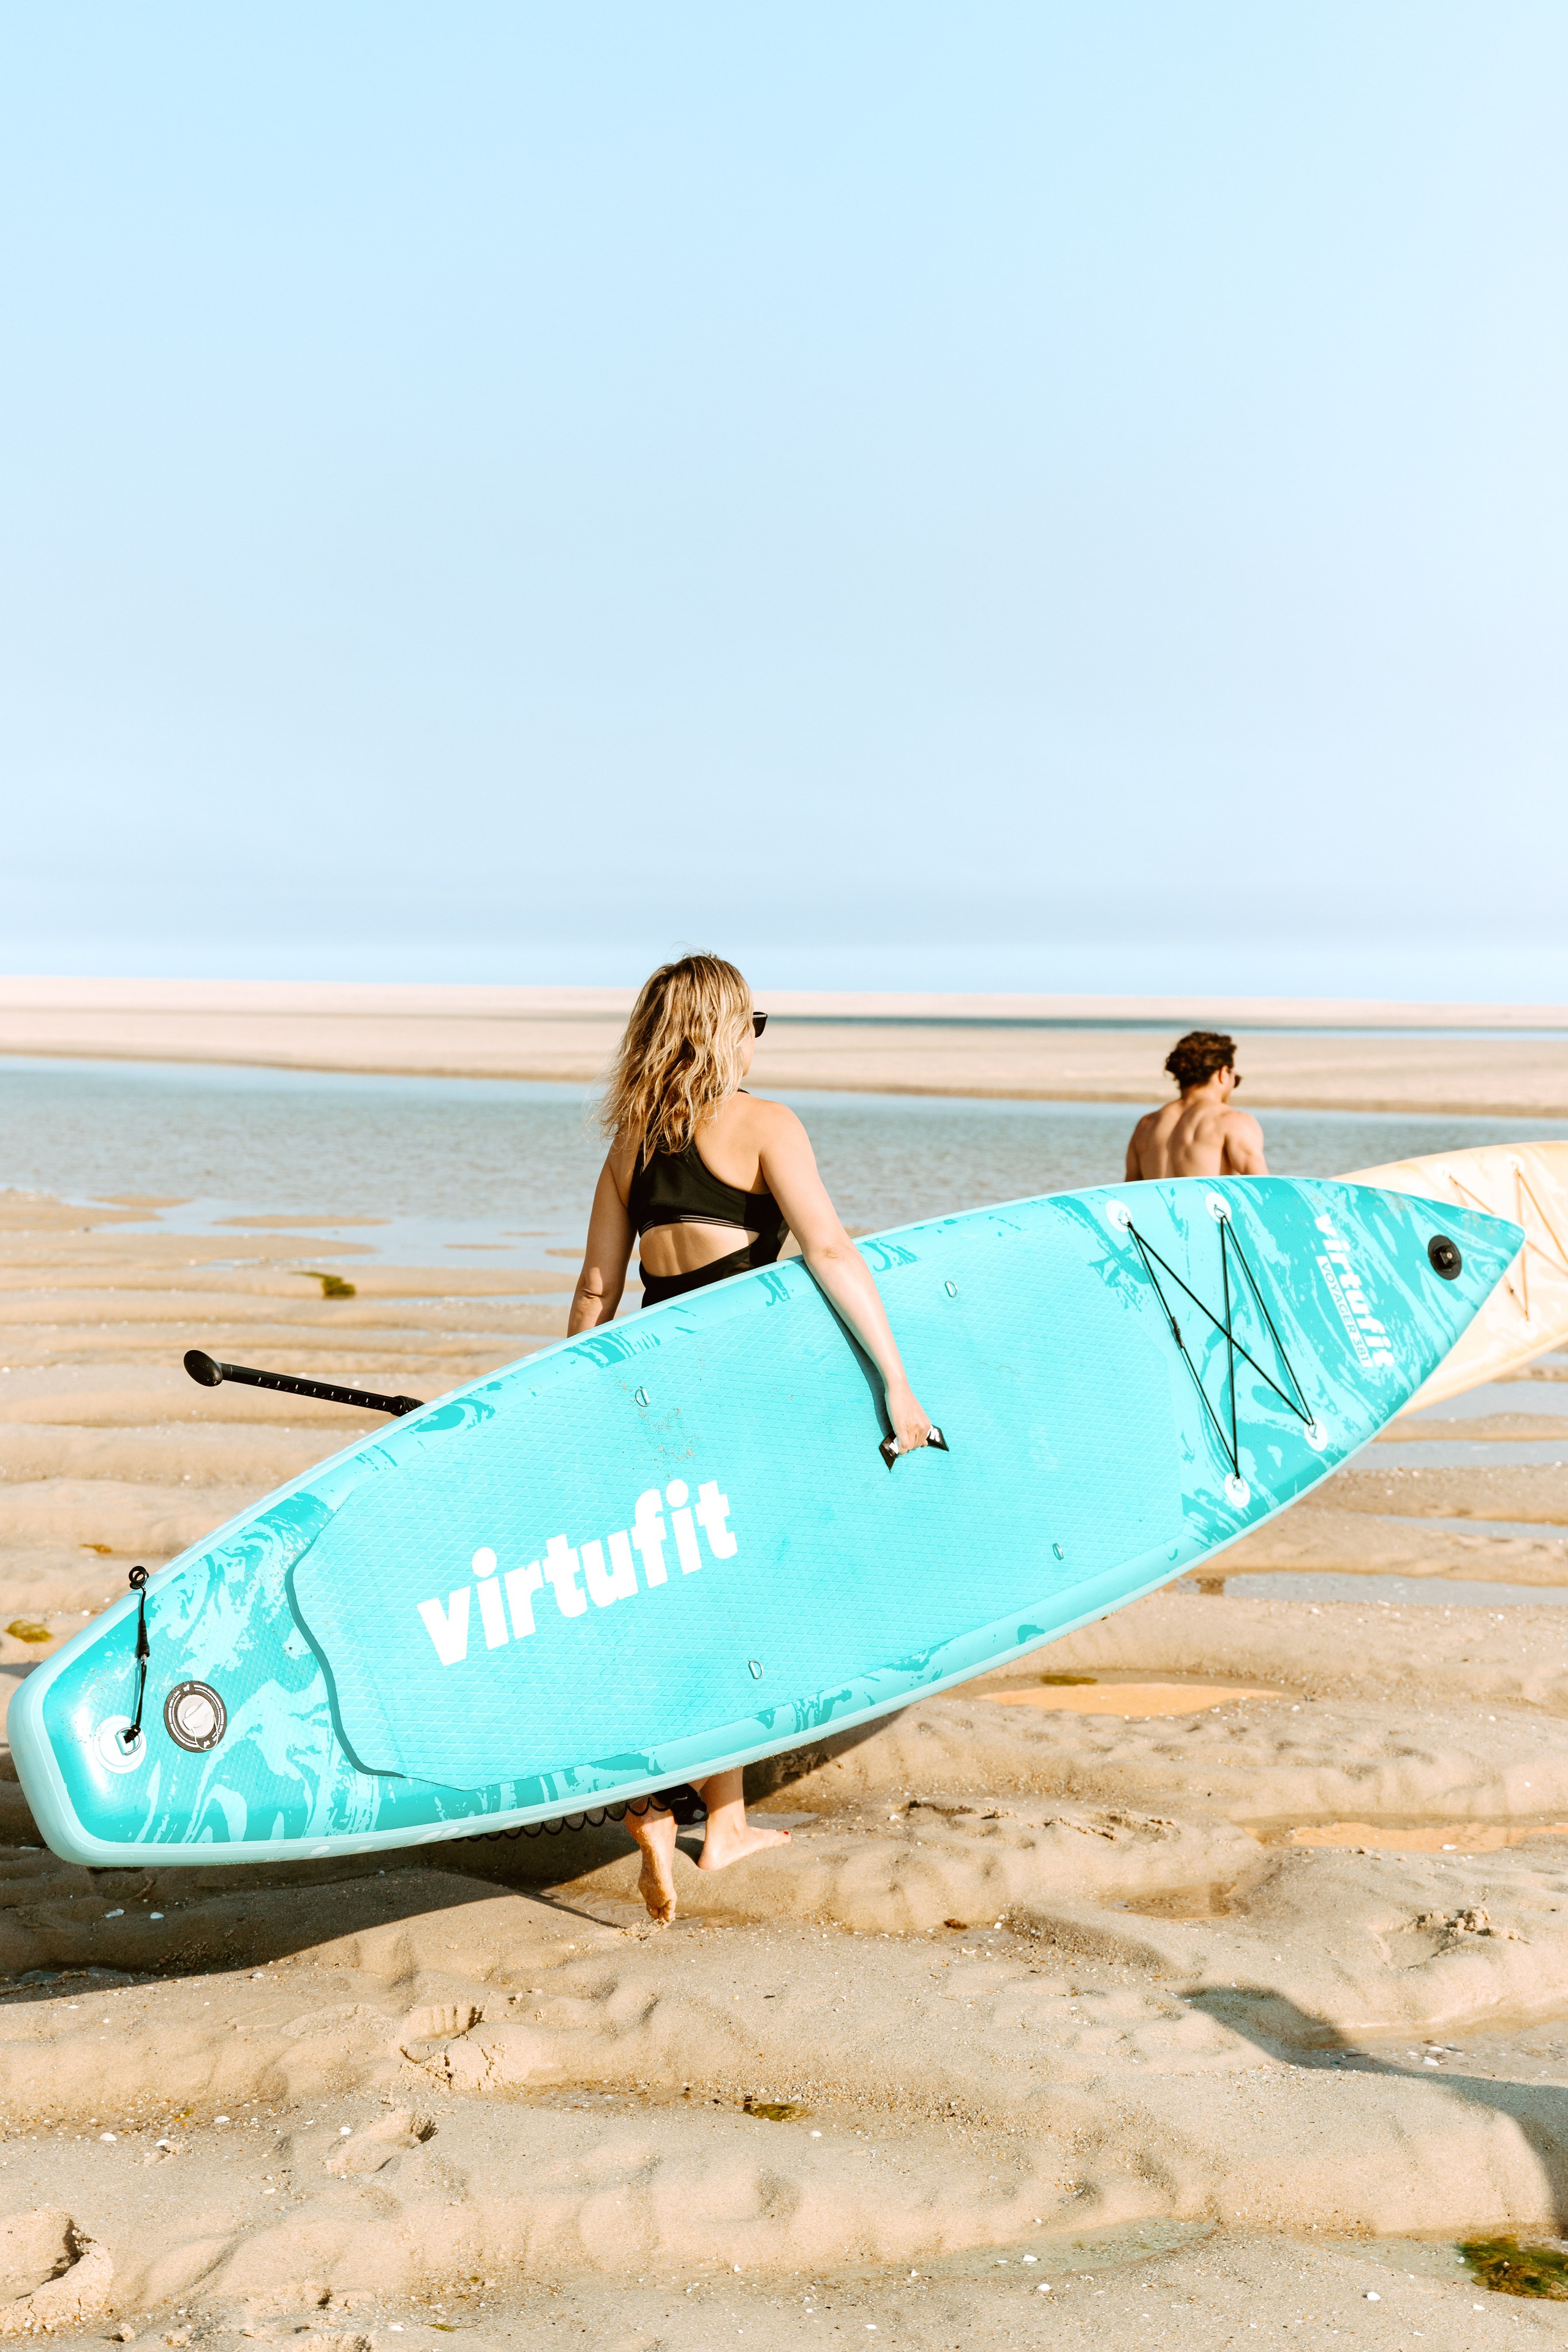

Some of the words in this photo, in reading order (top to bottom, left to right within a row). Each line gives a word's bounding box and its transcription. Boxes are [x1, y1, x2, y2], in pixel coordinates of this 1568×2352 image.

[1315, 1214, 1395, 1366] virtufit
[1322, 1262, 1356, 1333] VOYAGER
[1352, 1339, 1369, 1361] 381
[417, 1479, 737, 1666] virtufit
